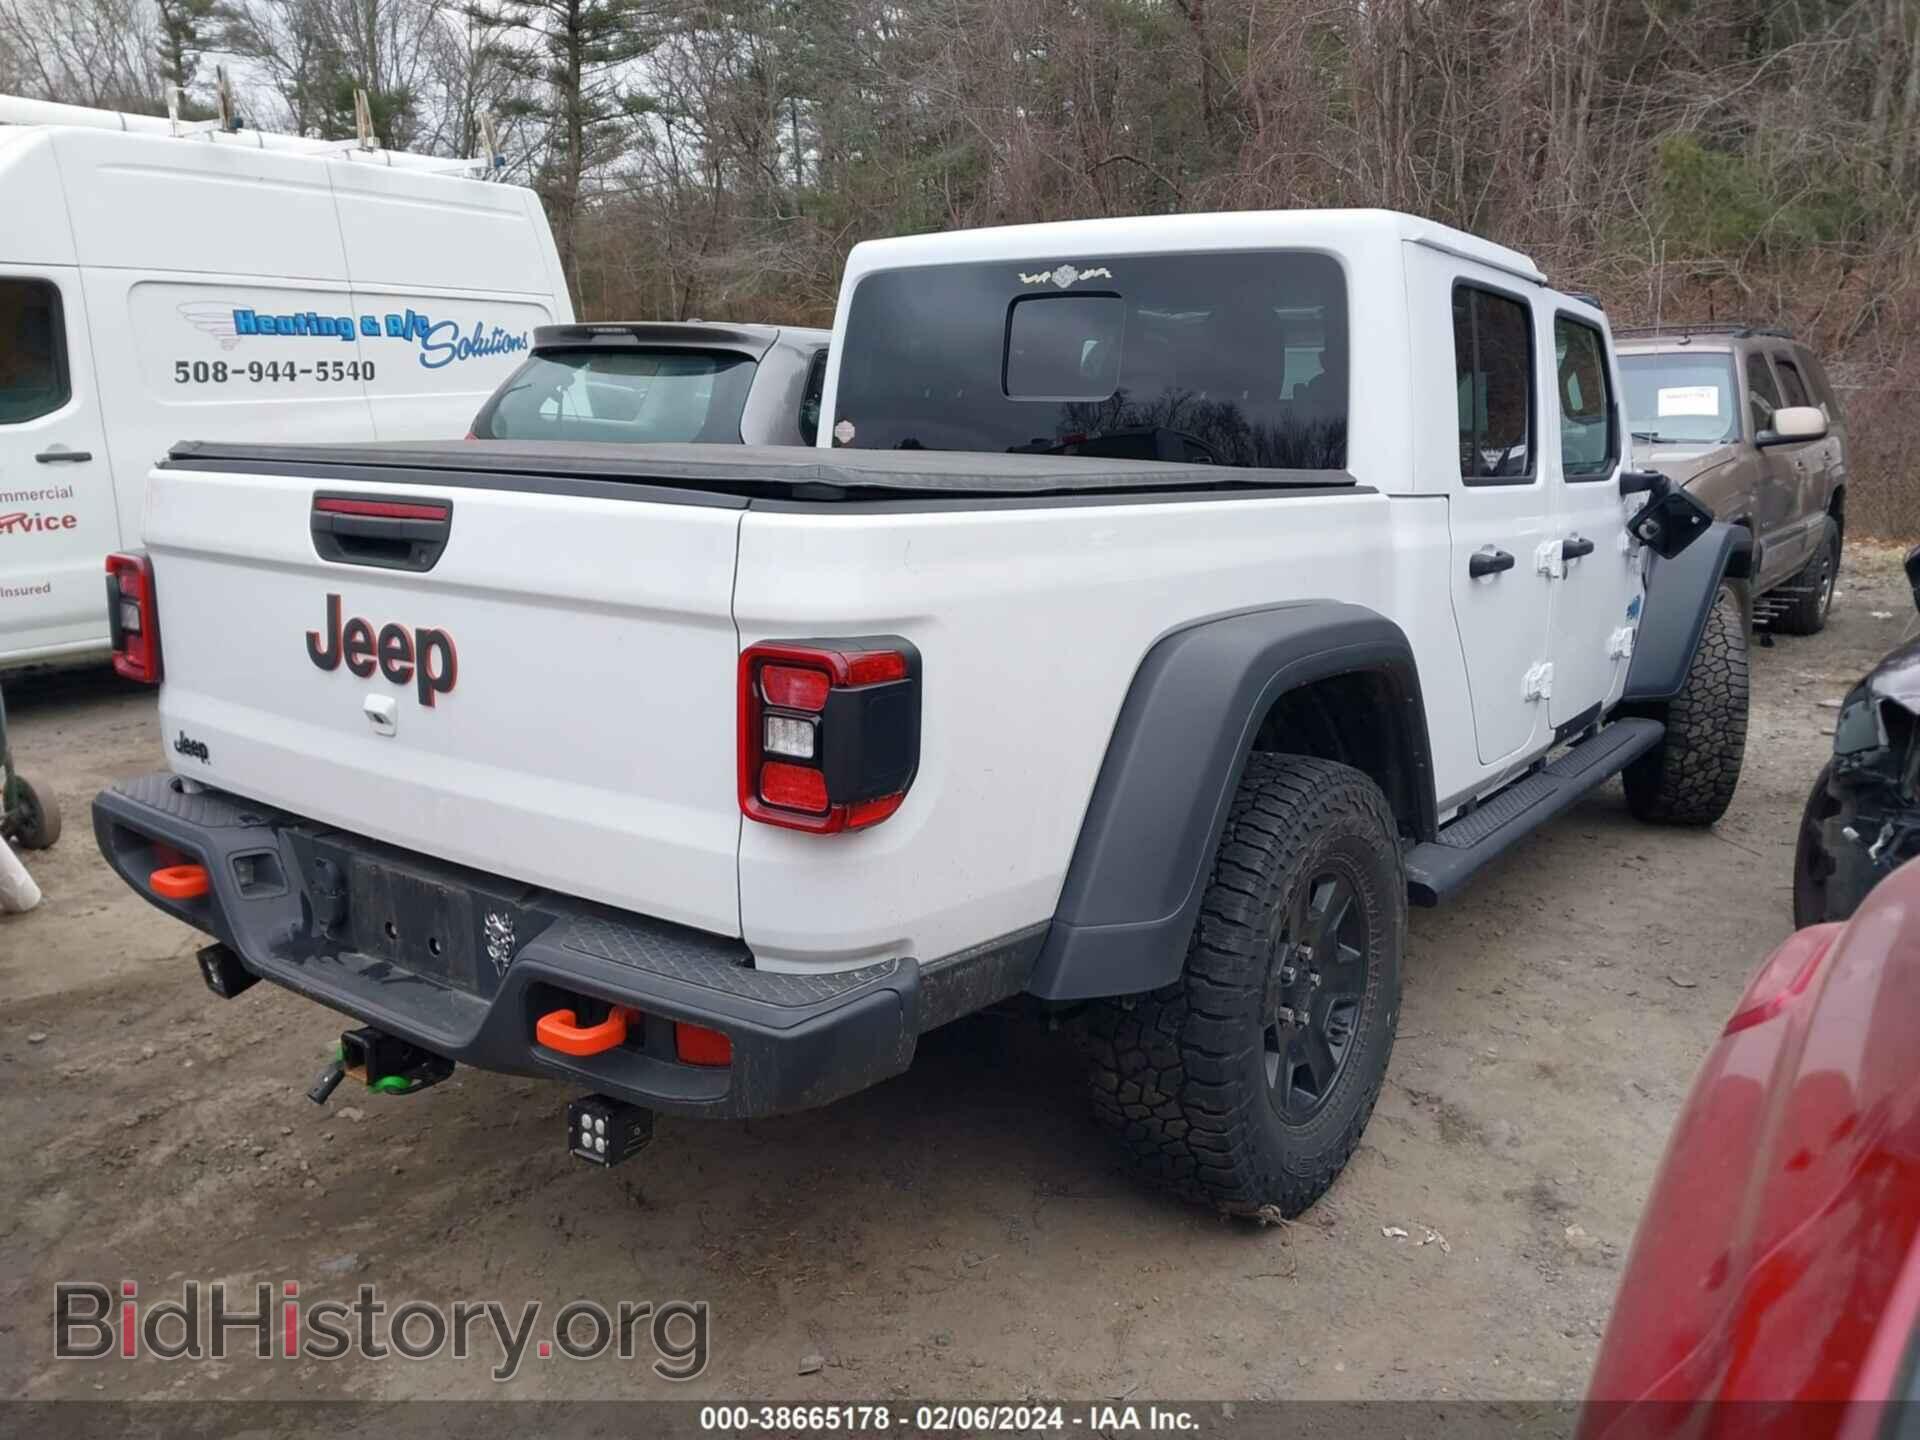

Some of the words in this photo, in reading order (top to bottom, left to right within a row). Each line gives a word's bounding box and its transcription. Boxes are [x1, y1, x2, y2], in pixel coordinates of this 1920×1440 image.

[233, 309, 355, 341] Heating
[360, 315, 381, 336] &
[419, 320, 528, 369] Solutions
[174, 360, 376, 384] 508-944-5540
[0, 484, 73, 503] mmercial
[0, 513, 77, 534] rvice
[0, 582, 51, 598] Insured
[305, 592, 458, 708] Jeep
[174, 730, 208, 764] Jeep
